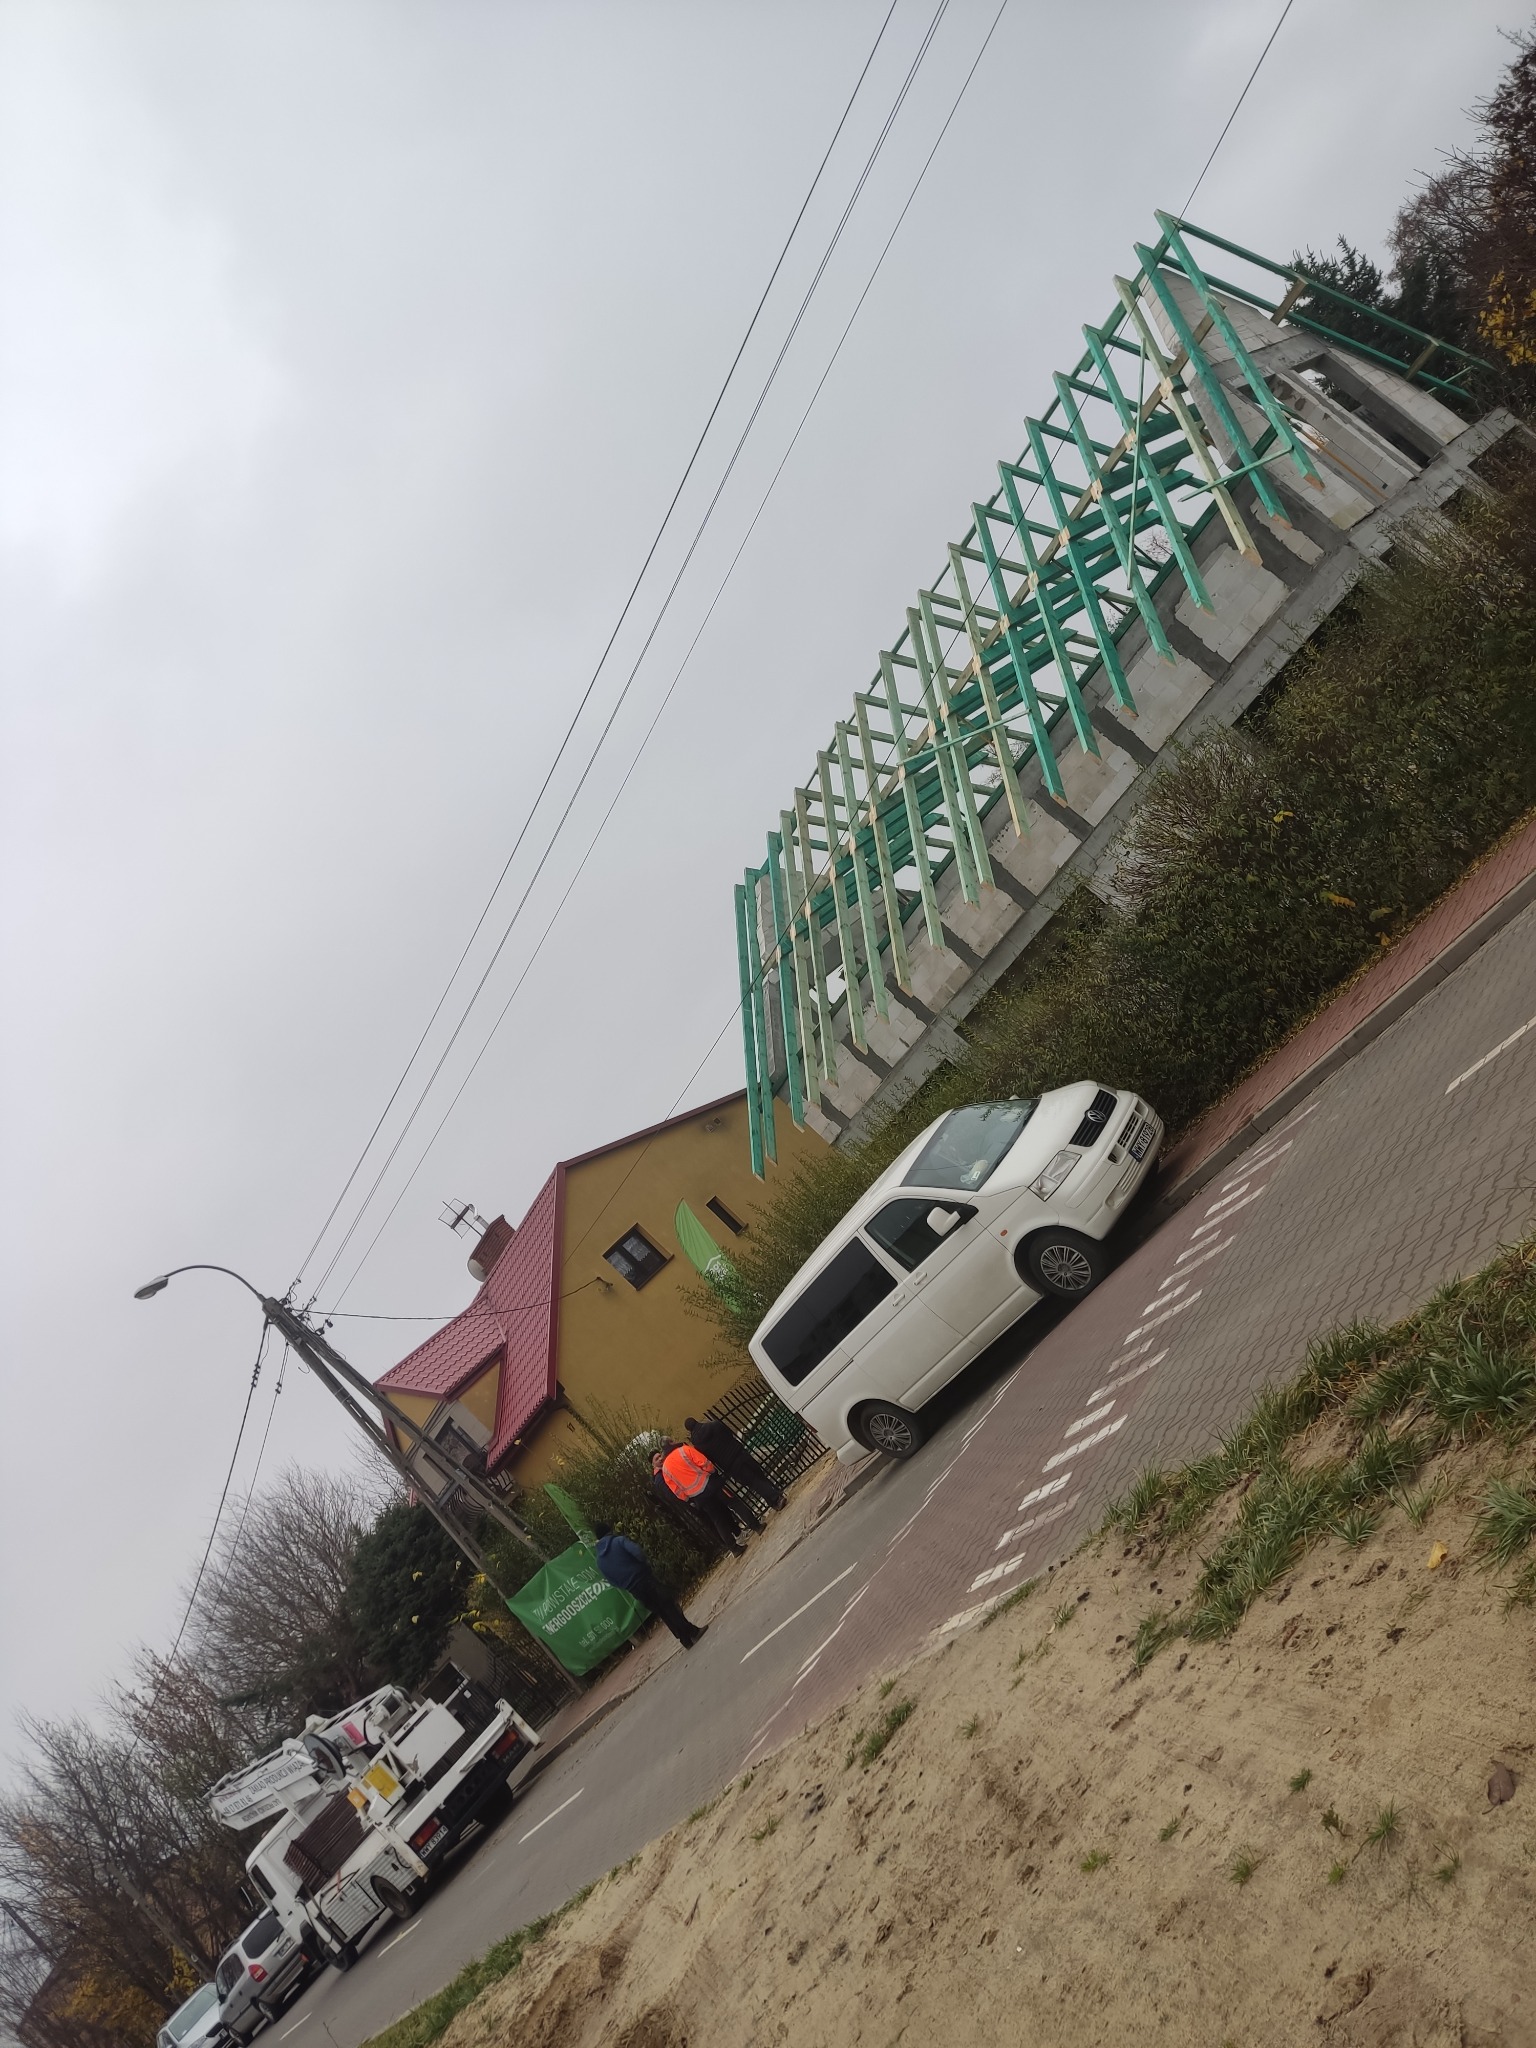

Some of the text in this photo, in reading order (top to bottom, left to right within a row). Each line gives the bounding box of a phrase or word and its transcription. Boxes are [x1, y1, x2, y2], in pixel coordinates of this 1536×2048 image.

[1132, 1141, 1146, 1158] WWY
[542, 1577, 580, 1616] POWSTAJE
[542, 1578, 611, 1635] ENERGOOSZCZĘDN
[421, 1826, 448, 1857] WWY 83914
